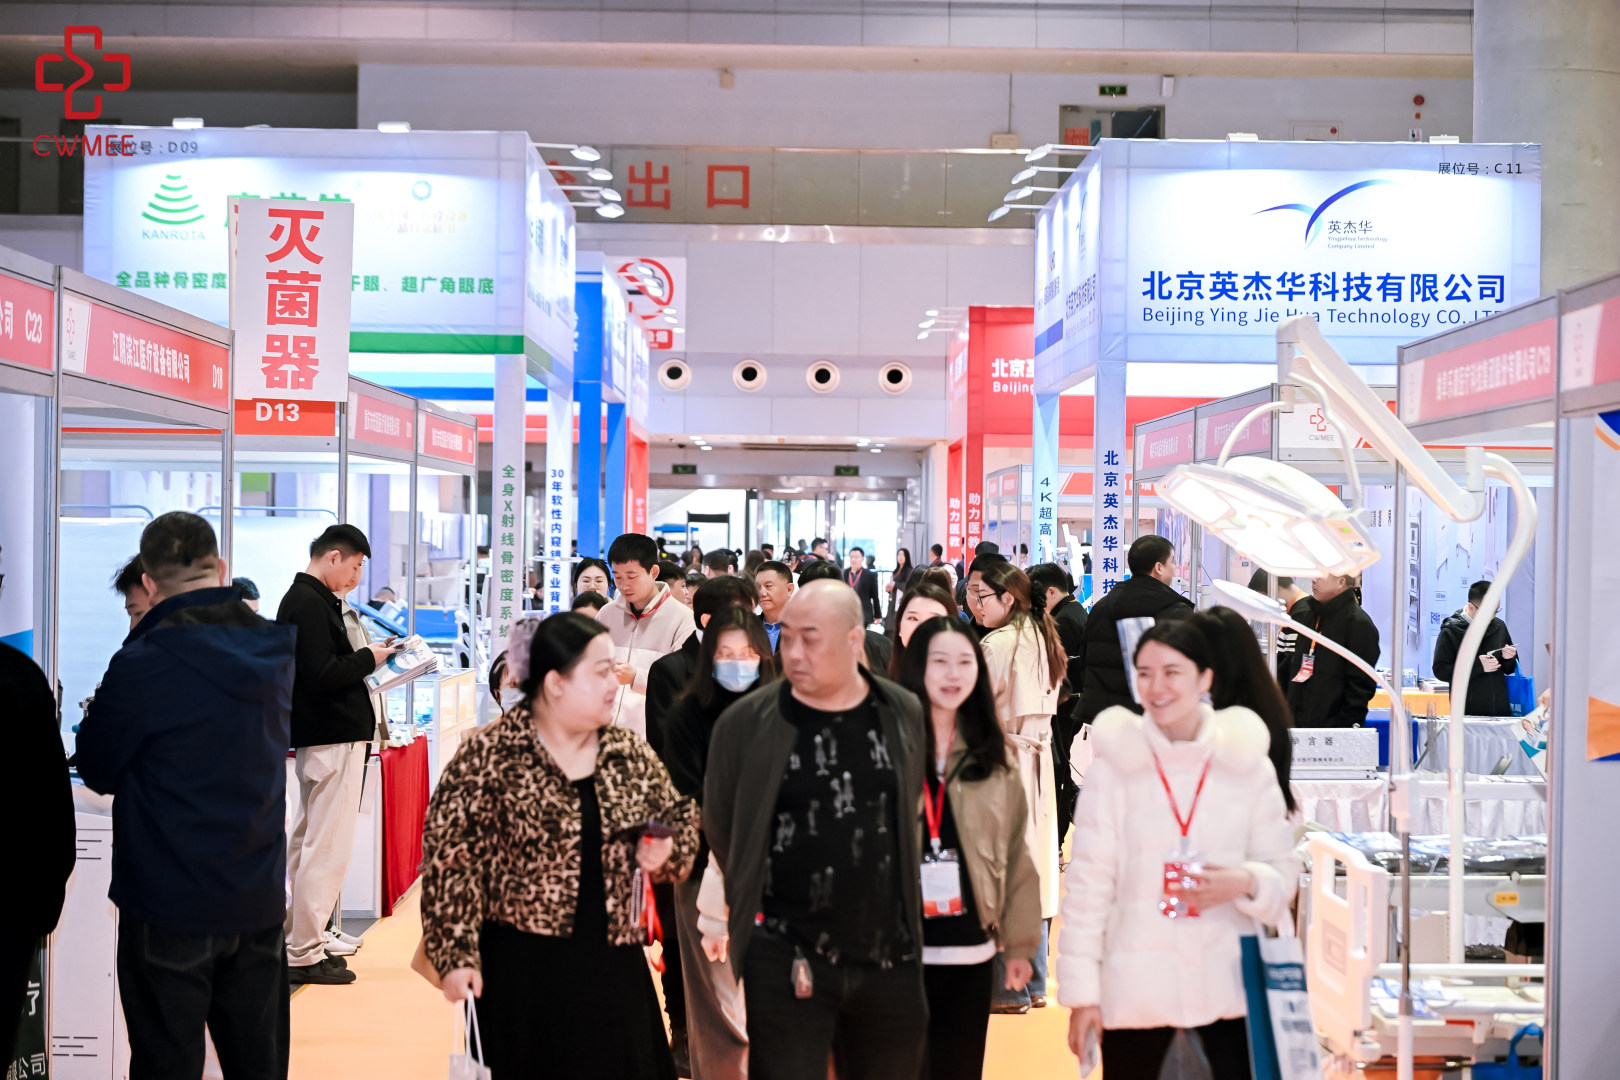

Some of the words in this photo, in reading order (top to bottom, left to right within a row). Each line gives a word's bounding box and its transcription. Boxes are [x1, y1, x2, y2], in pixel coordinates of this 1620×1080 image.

[141, 229, 206, 241] KANROTA
[1328, 220, 1373, 234] 英杰华
[115, 271, 228, 290] 全品种骨密度
[1142, 270, 1505, 304] 北京英杰华科技有限公司
[260, 208, 325, 391] 灭菌器
[25, 308, 43, 344] C23
[1143, 307, 1204, 327] Beijing
[1210, 308, 1248, 327] Ying
[1254, 308, 1280, 324] Jie
[1327, 308, 1431, 328] Technology
[255, 402, 300, 422] D13
[1308, 434, 1335, 442] CWMEE
